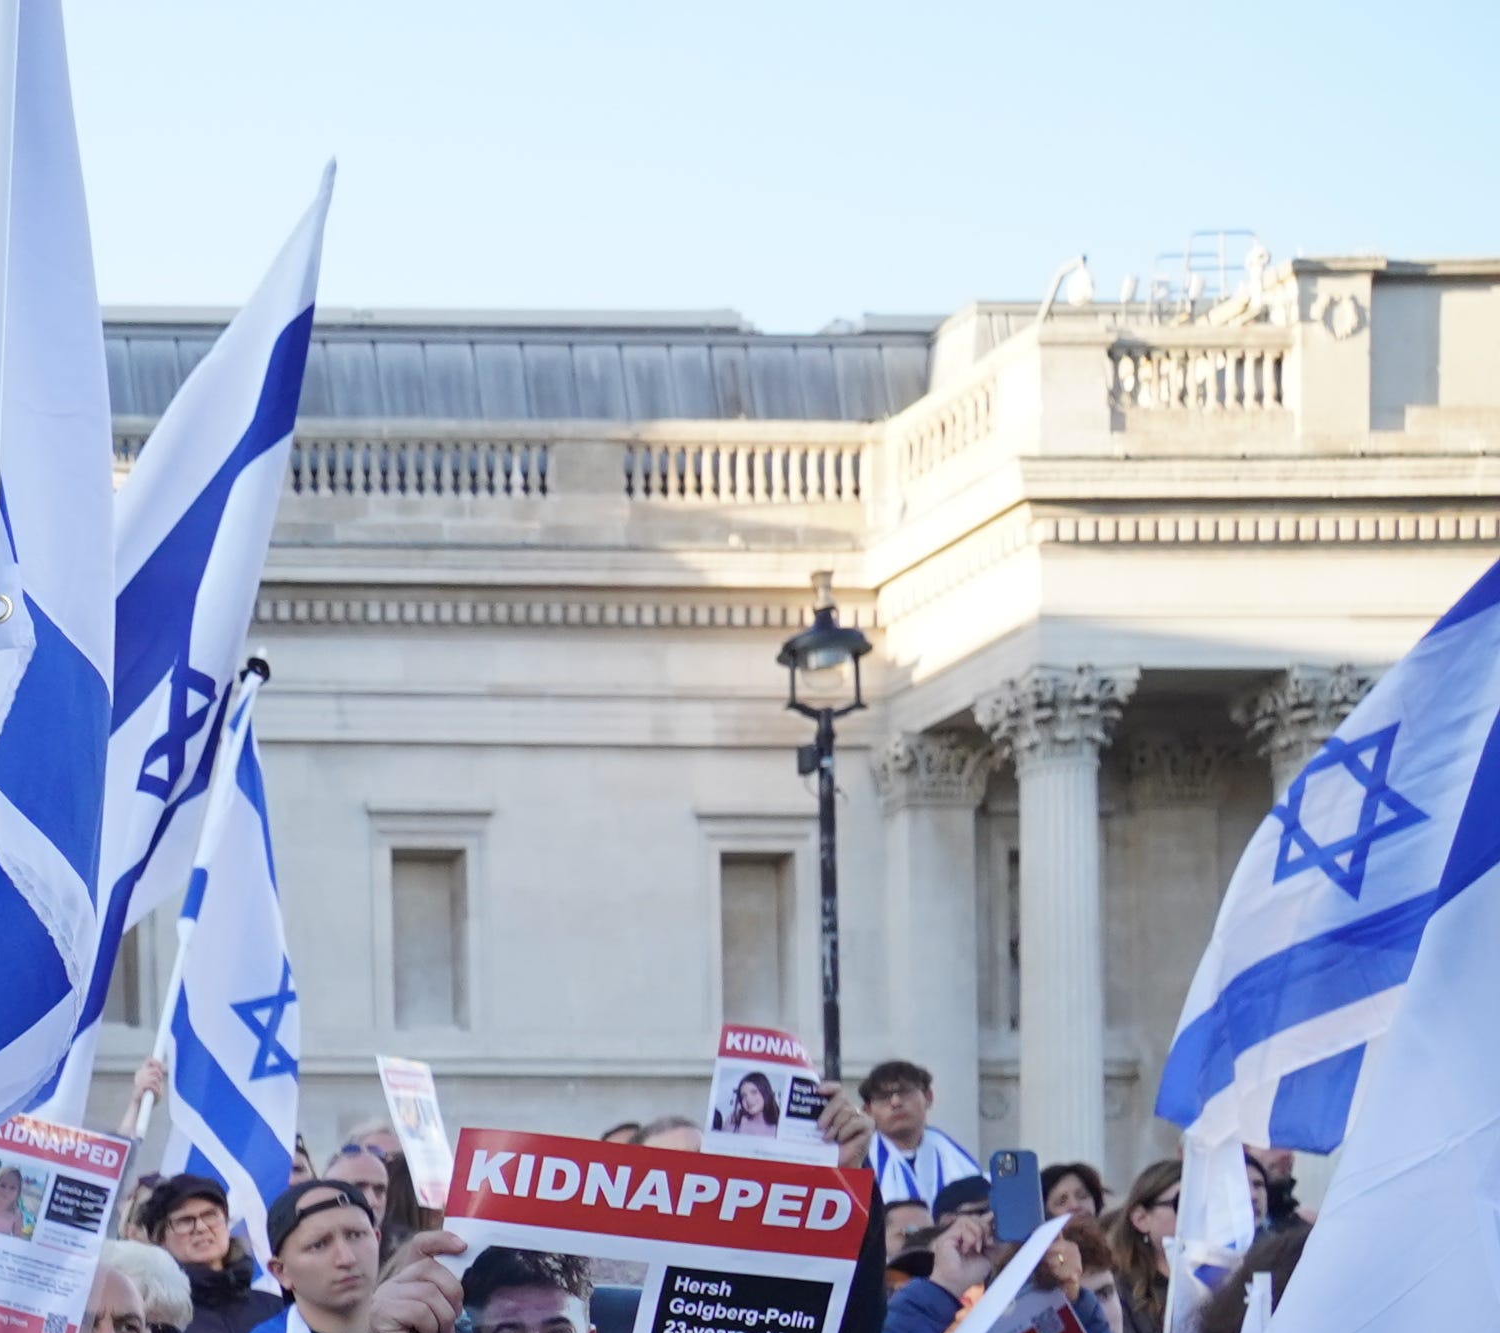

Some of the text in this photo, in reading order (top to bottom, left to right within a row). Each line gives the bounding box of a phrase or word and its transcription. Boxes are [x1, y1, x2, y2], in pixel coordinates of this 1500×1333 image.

[726, 1032, 808, 1060] KIDNAP
[465, 1149, 852, 1232] KIDNAPPED
[674, 1275, 732, 1298] Hersh
[668, 1298, 815, 1330] Golgberg-Polin
